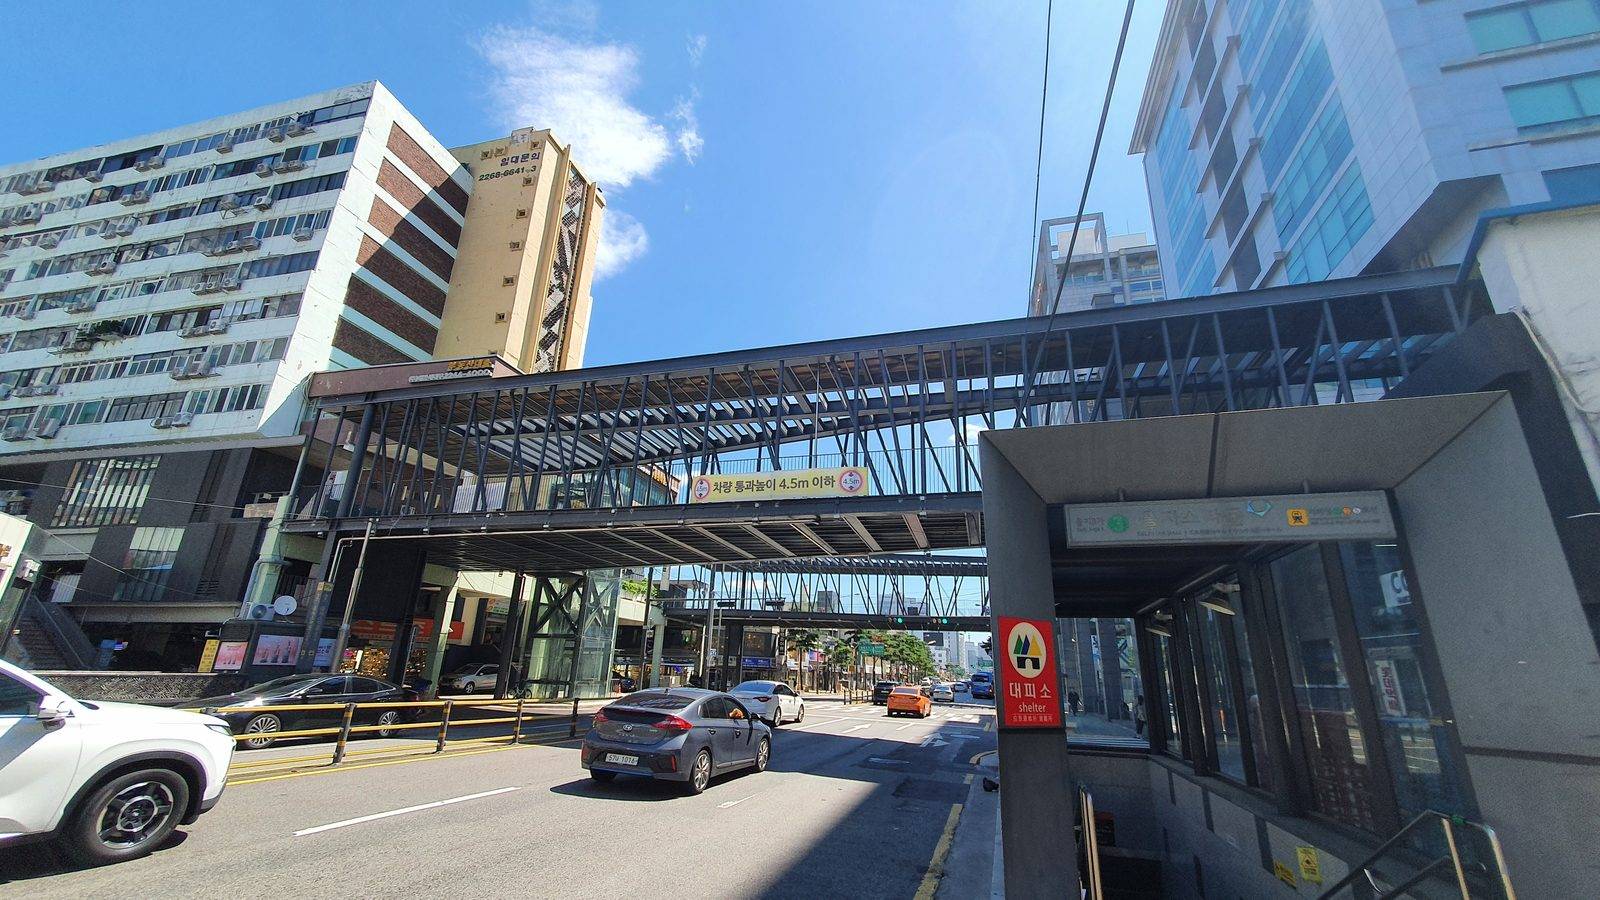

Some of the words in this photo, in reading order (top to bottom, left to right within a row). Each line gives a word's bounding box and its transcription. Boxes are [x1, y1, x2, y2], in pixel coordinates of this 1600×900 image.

[501, 152, 540, 167] 임대문의
[713, 481, 732, 494] 차량
[734, 478, 776, 493] 통과높이
[779, 477, 809, 490] 4.5m
[812, 475, 836, 488] 이하
[1009, 682, 1052, 699] 대피소
[1018, 702, 1047, 713] shelter
